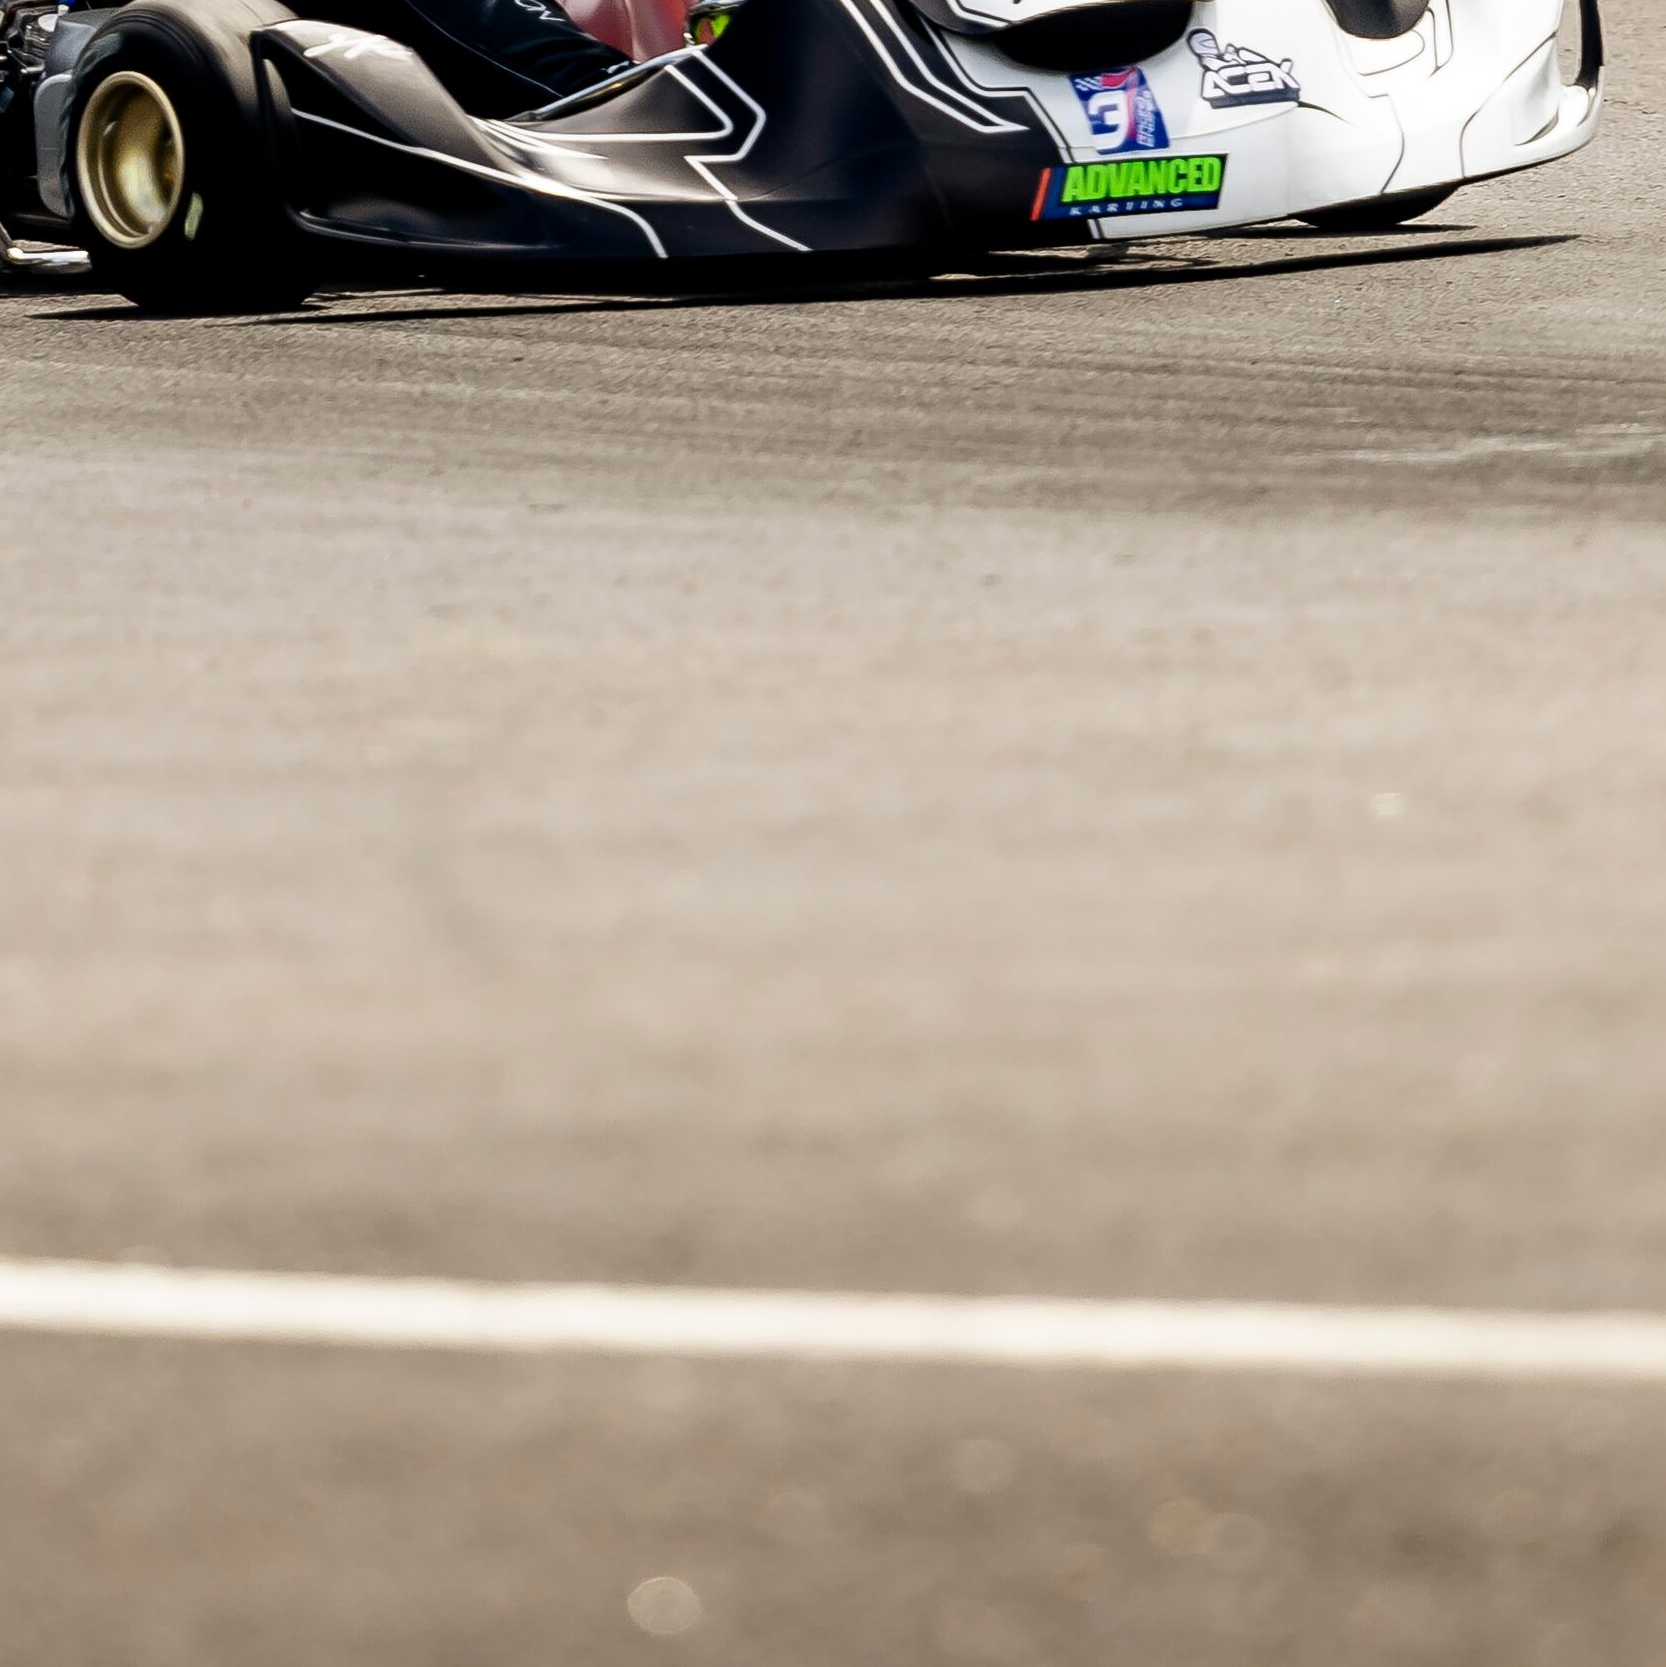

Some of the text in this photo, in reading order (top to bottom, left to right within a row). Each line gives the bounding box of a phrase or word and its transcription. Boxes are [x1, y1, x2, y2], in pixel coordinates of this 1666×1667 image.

[1087, 89, 1131, 151] 3
[1061, 156, 1222, 203] ADVANCED
[1068, 197, 1185, 216] KARTING
